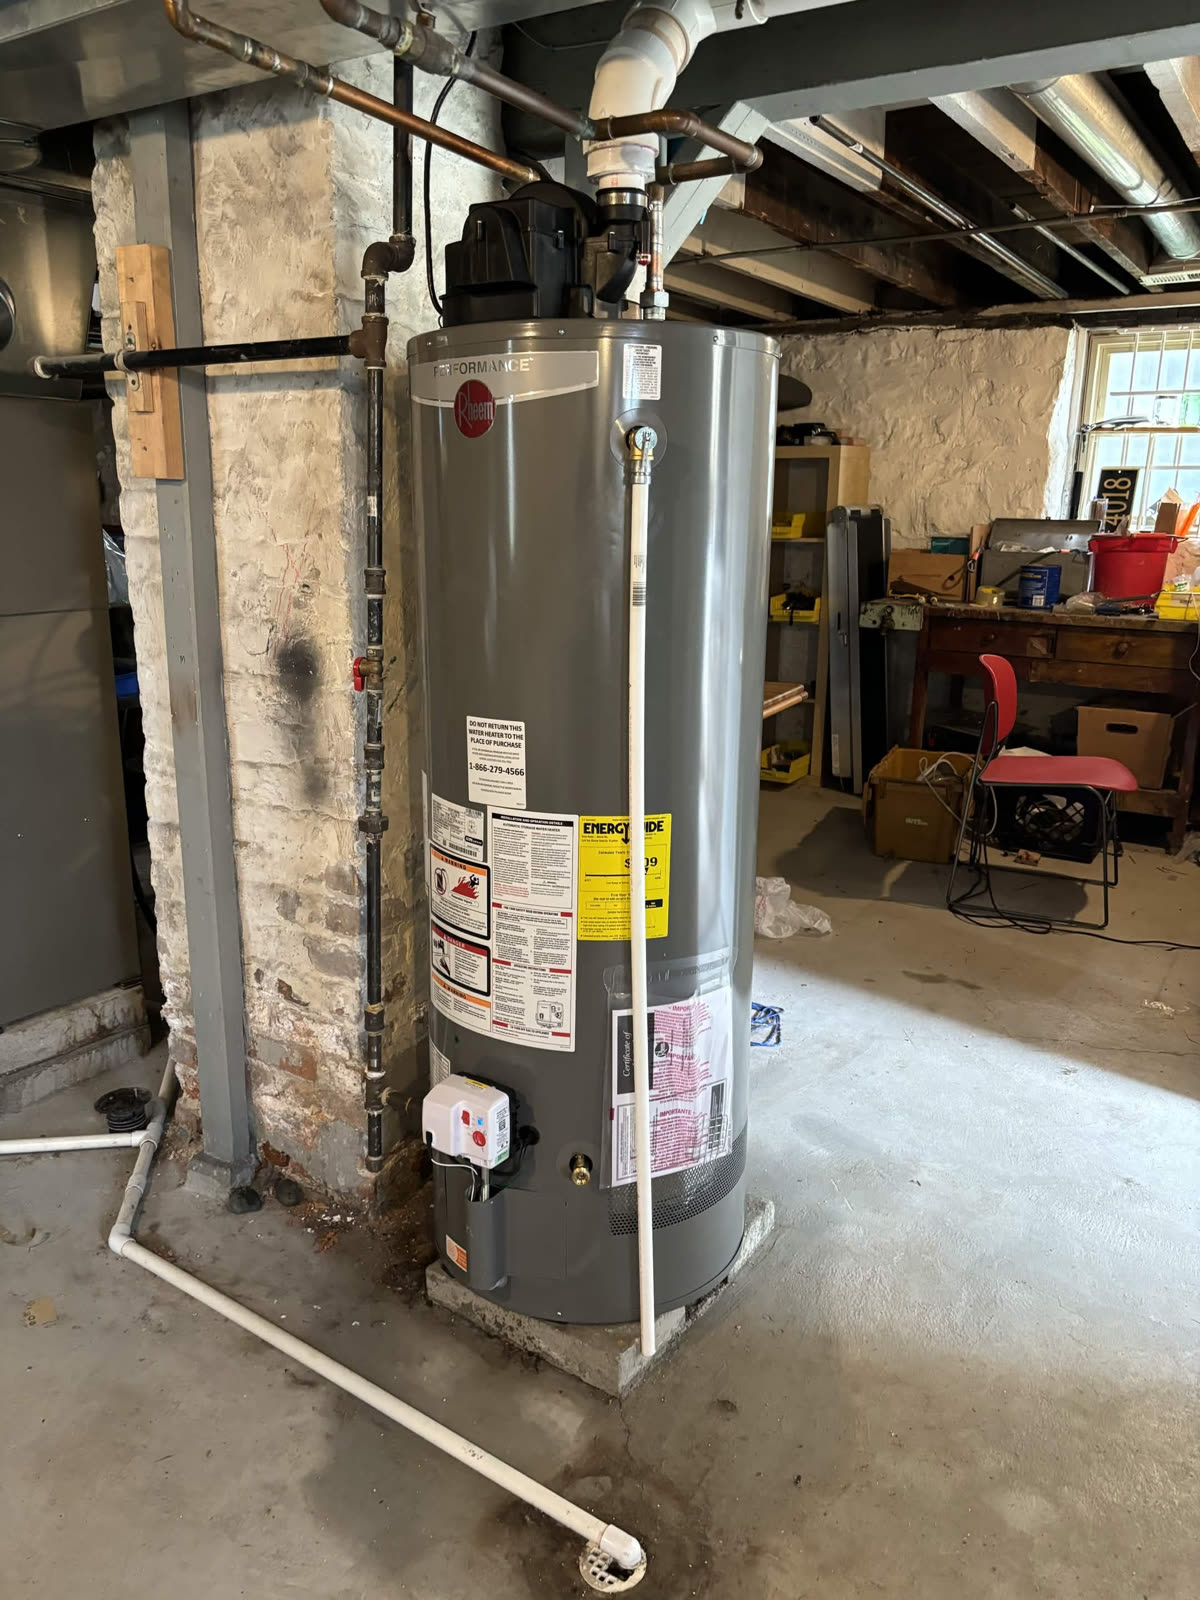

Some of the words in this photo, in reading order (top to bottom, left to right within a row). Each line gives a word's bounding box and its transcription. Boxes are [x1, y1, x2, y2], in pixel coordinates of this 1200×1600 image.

[433, 359, 530, 377] PERFORMANCE
[458, 382, 493, 429] Rheem
[1102, 477, 1131, 526] 4018
[485, 730, 504, 738] HEATER
[488, 723, 508, 731] RETURN
[493, 740, 522, 748] PURCHASE
[469, 762, 524, 776] 1-866-279-4566
[583, 820, 664, 842] ENERGYIDE
[622, 1030, 632, 1040] of
[622, 1040, 632, 1077] Certificate
[660, 1108, 692, 1117] IMPORTANTE
